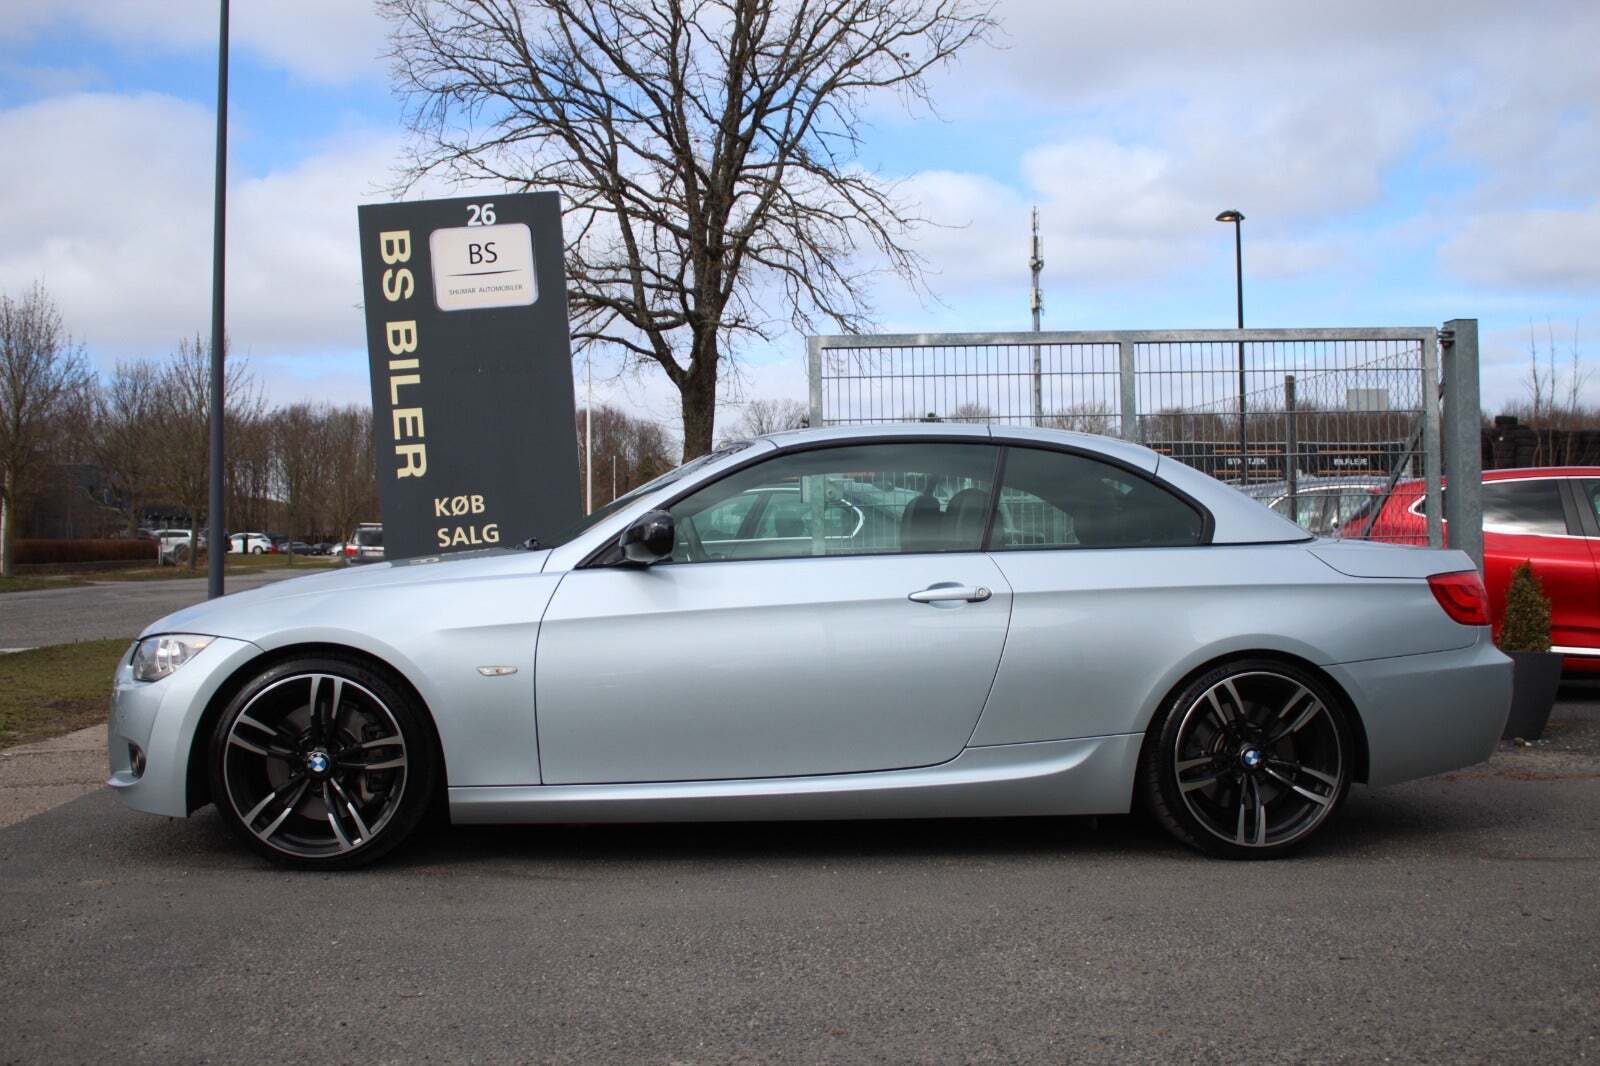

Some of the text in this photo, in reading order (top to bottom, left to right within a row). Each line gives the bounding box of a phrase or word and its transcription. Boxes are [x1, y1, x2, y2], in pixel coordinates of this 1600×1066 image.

[466, 203, 497, 227] 26
[468, 242, 498, 265] BS
[478, 284, 523, 293] AUTOMOBILER
[379, 230, 428, 479] BS BILER
[434, 495, 486, 517] KØB
[437, 524, 500, 548] SALG
